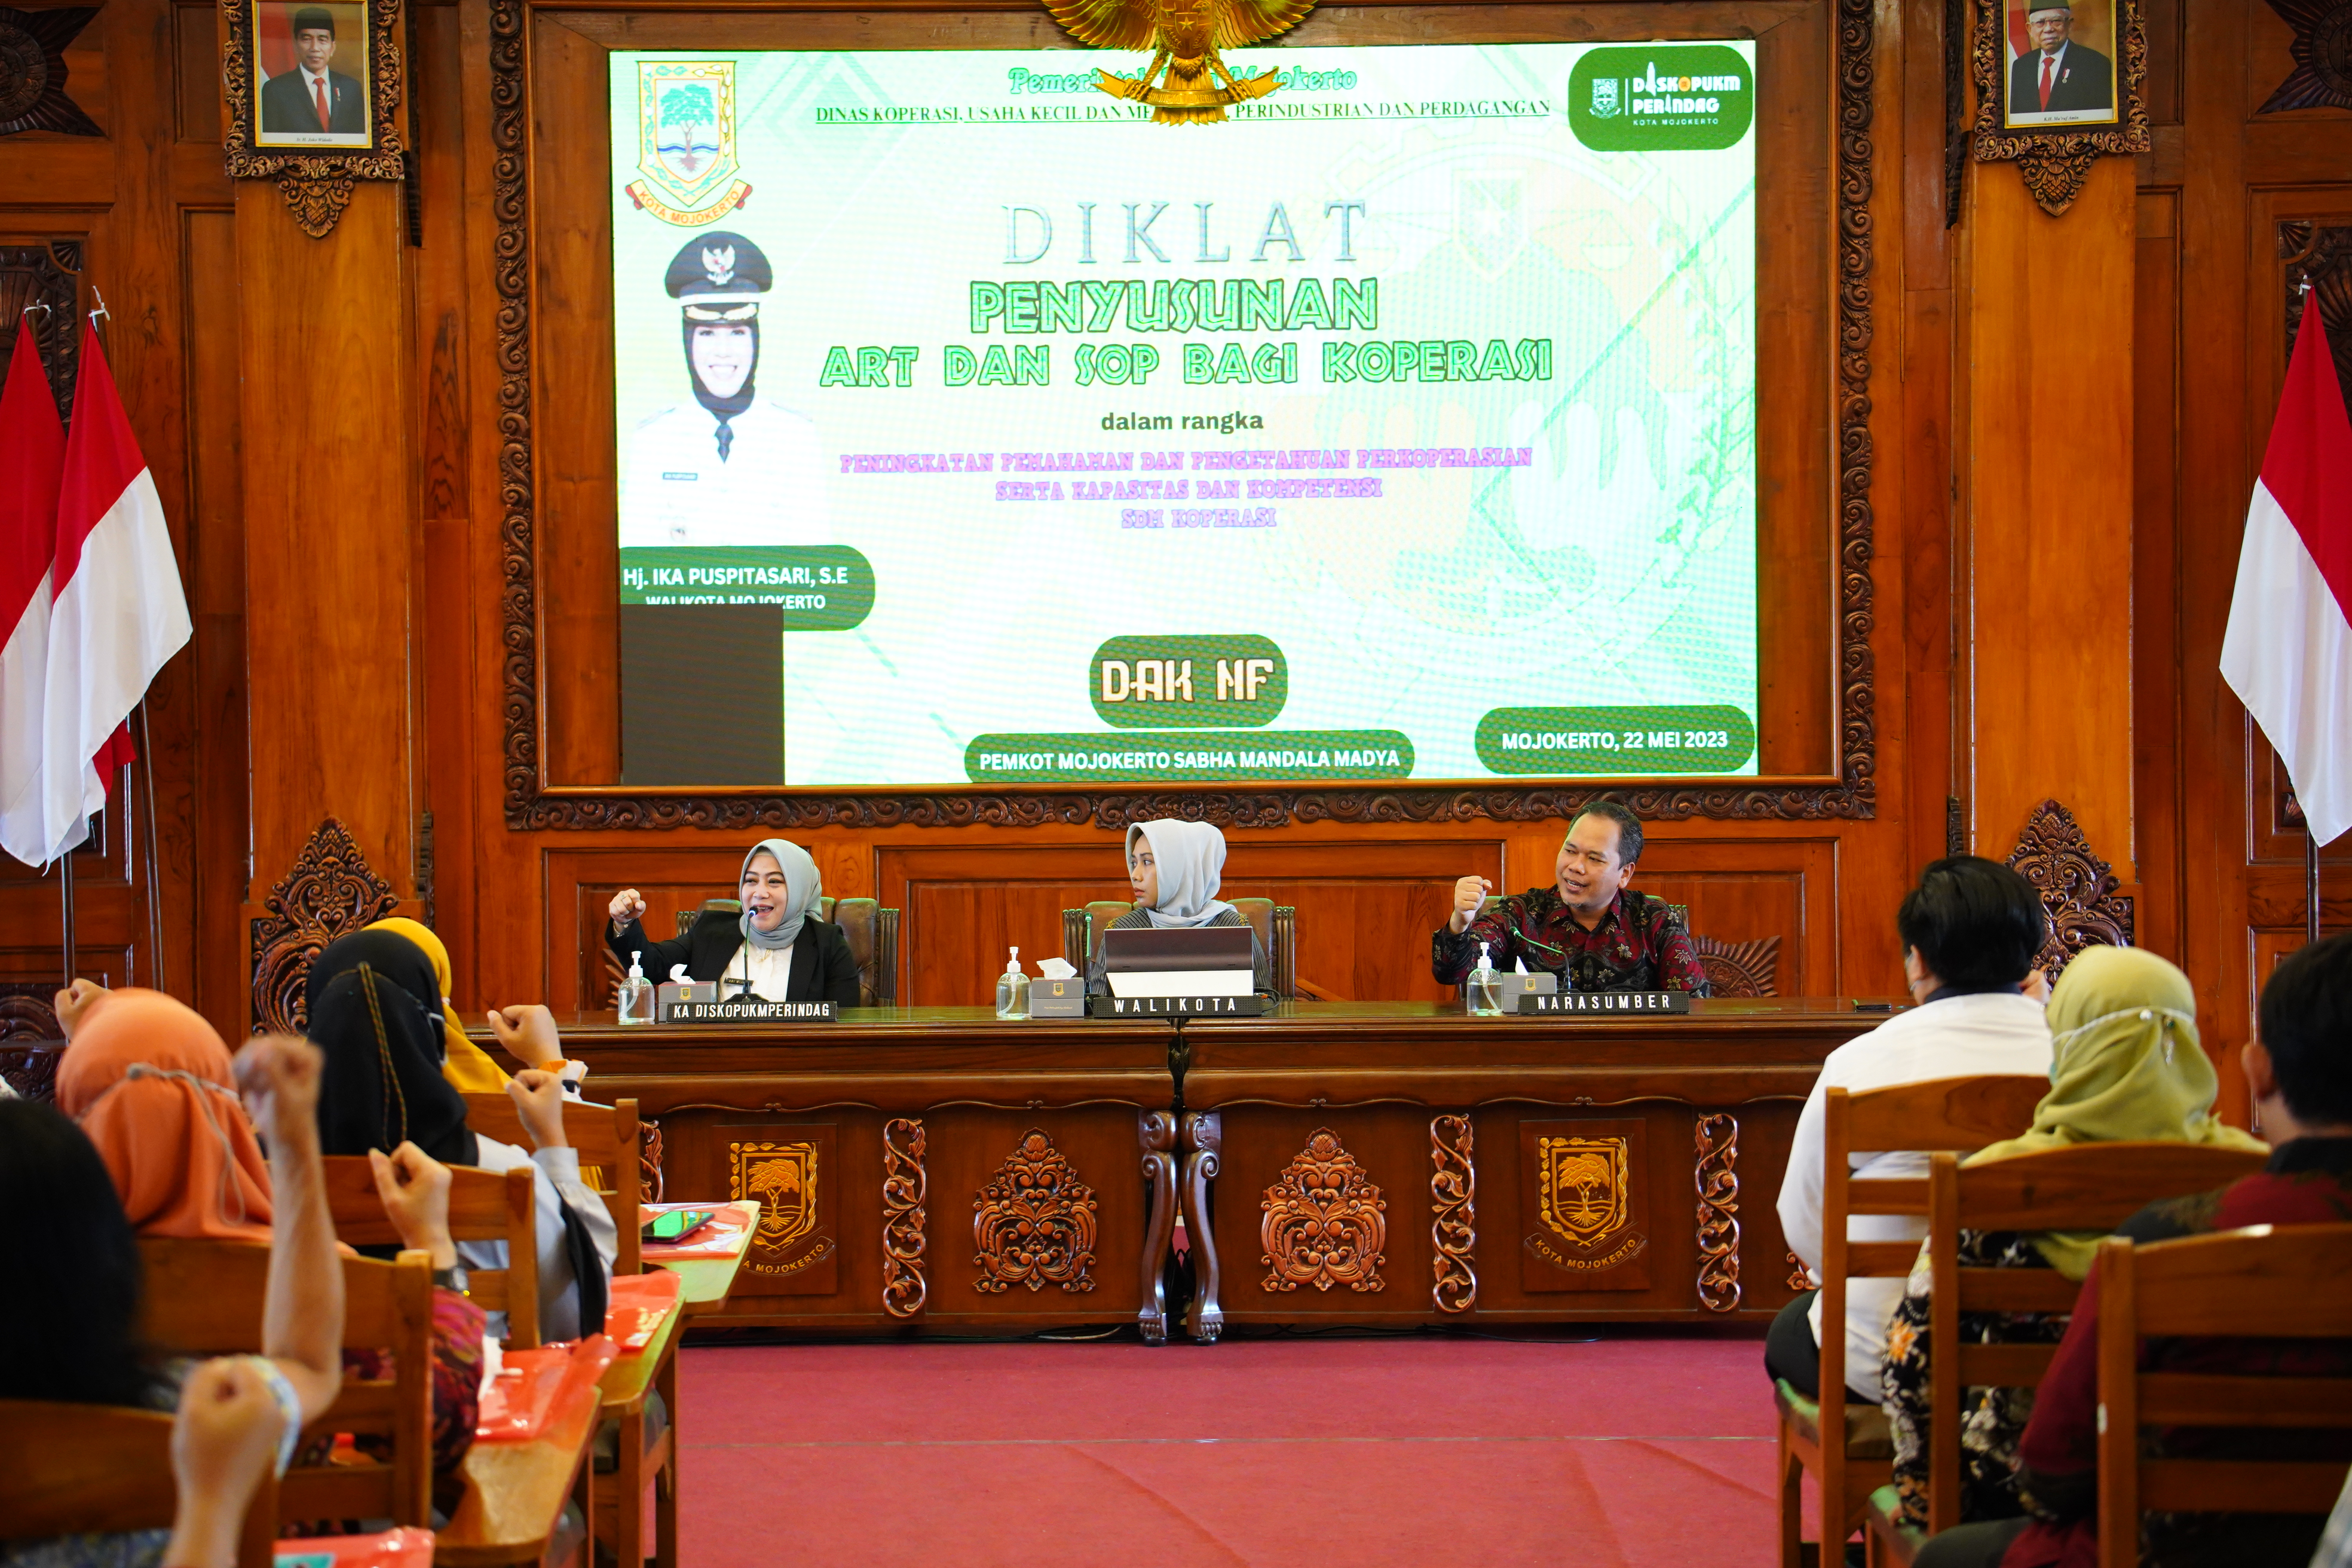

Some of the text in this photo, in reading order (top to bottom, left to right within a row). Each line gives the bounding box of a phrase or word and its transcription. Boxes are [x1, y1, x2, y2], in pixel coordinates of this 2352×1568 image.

[1008, 68, 1146, 94] Pemeri
[816, 107, 869, 121] DINAS
[874, 107, 963, 122] KOPERASI,
[968, 106, 1026, 121] USAHA
[1031, 106, 1081, 120] KECIL
[1086, 106, 1123, 120] DAN
[1235, 103, 1373, 118] PERINDUSTRIAN
[1379, 102, 1414, 117] DAN
[1420, 100, 1551, 115] PERDAGANGAN
[639, 191, 739, 224] KOTA MOJOKERTO
[1003, 200, 1367, 264] DIKLAT
[970, 278, 1378, 333] PENYUSUNAN
[820, 338, 1553, 387] ART DAN SOP BAGI KOPERASI
[1101, 411, 1264, 434] dalam rangka
[840, 447, 1533, 473] PENINGKATAN PEMAHAMAN DAN PENGETAHUAN PERKOPERASIAN
[995, 477, 1383, 501] SERTA KAPASITAS DAN KOMPETENSI
[1121, 507, 1277, 528] SDM KOPERASI
[623, 566, 849, 590] Hj. IKA PUSPITASARI, S.E
[1101, 658, 1275, 702] DAK NF
[1502, 730, 1728, 752] MOJOKERTO, 22 MEI 2023
[979, 749, 1400, 770] PEMKOT MOJOKERTO SABHA MANDALA MADYA
[673, 1003, 829, 1018] KA DISKOPUKMPERINDAG
[1114, 998, 1236, 1013] WALIKOTA
[1538, 994, 1670, 1010] NARASUMBER
[756, 1244, 824, 1273] MOJOKERTO
[1536, 1239, 1636, 1269] KOTA MOJOKERTO
